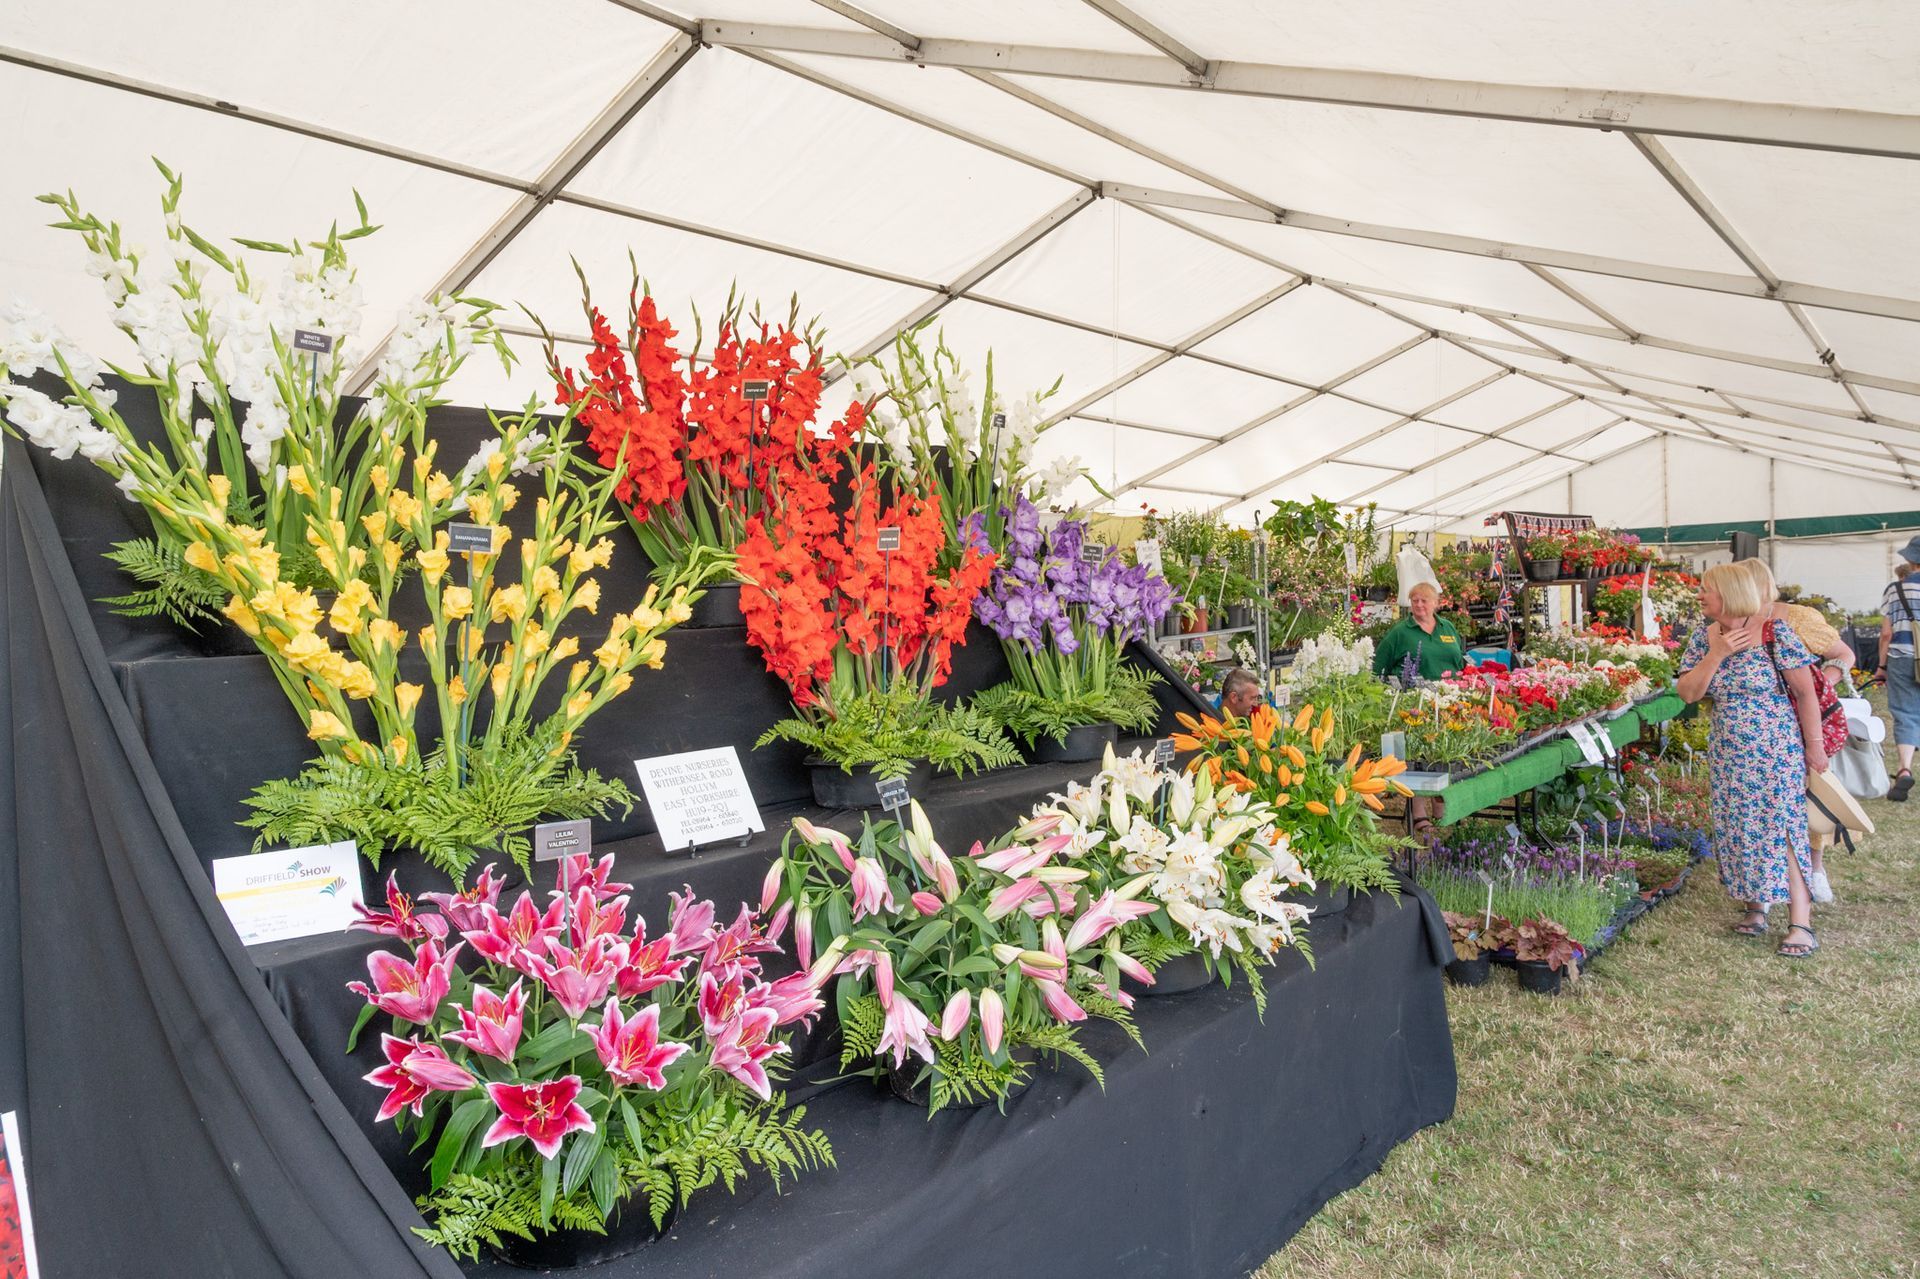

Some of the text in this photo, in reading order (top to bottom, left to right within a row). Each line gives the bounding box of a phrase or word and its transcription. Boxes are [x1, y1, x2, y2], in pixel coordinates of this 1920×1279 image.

[649, 758, 730, 779] DEVINE NURSERIES
[653, 768, 734, 789] WITHERNSEA ROAD
[680, 781, 718, 796] HOLLYM
[664, 788, 740, 811] EAST YORKSHIRE
[548, 839, 578, 848] VALENTINO
[246, 866, 331, 886] DRIFFIELD SHOW
